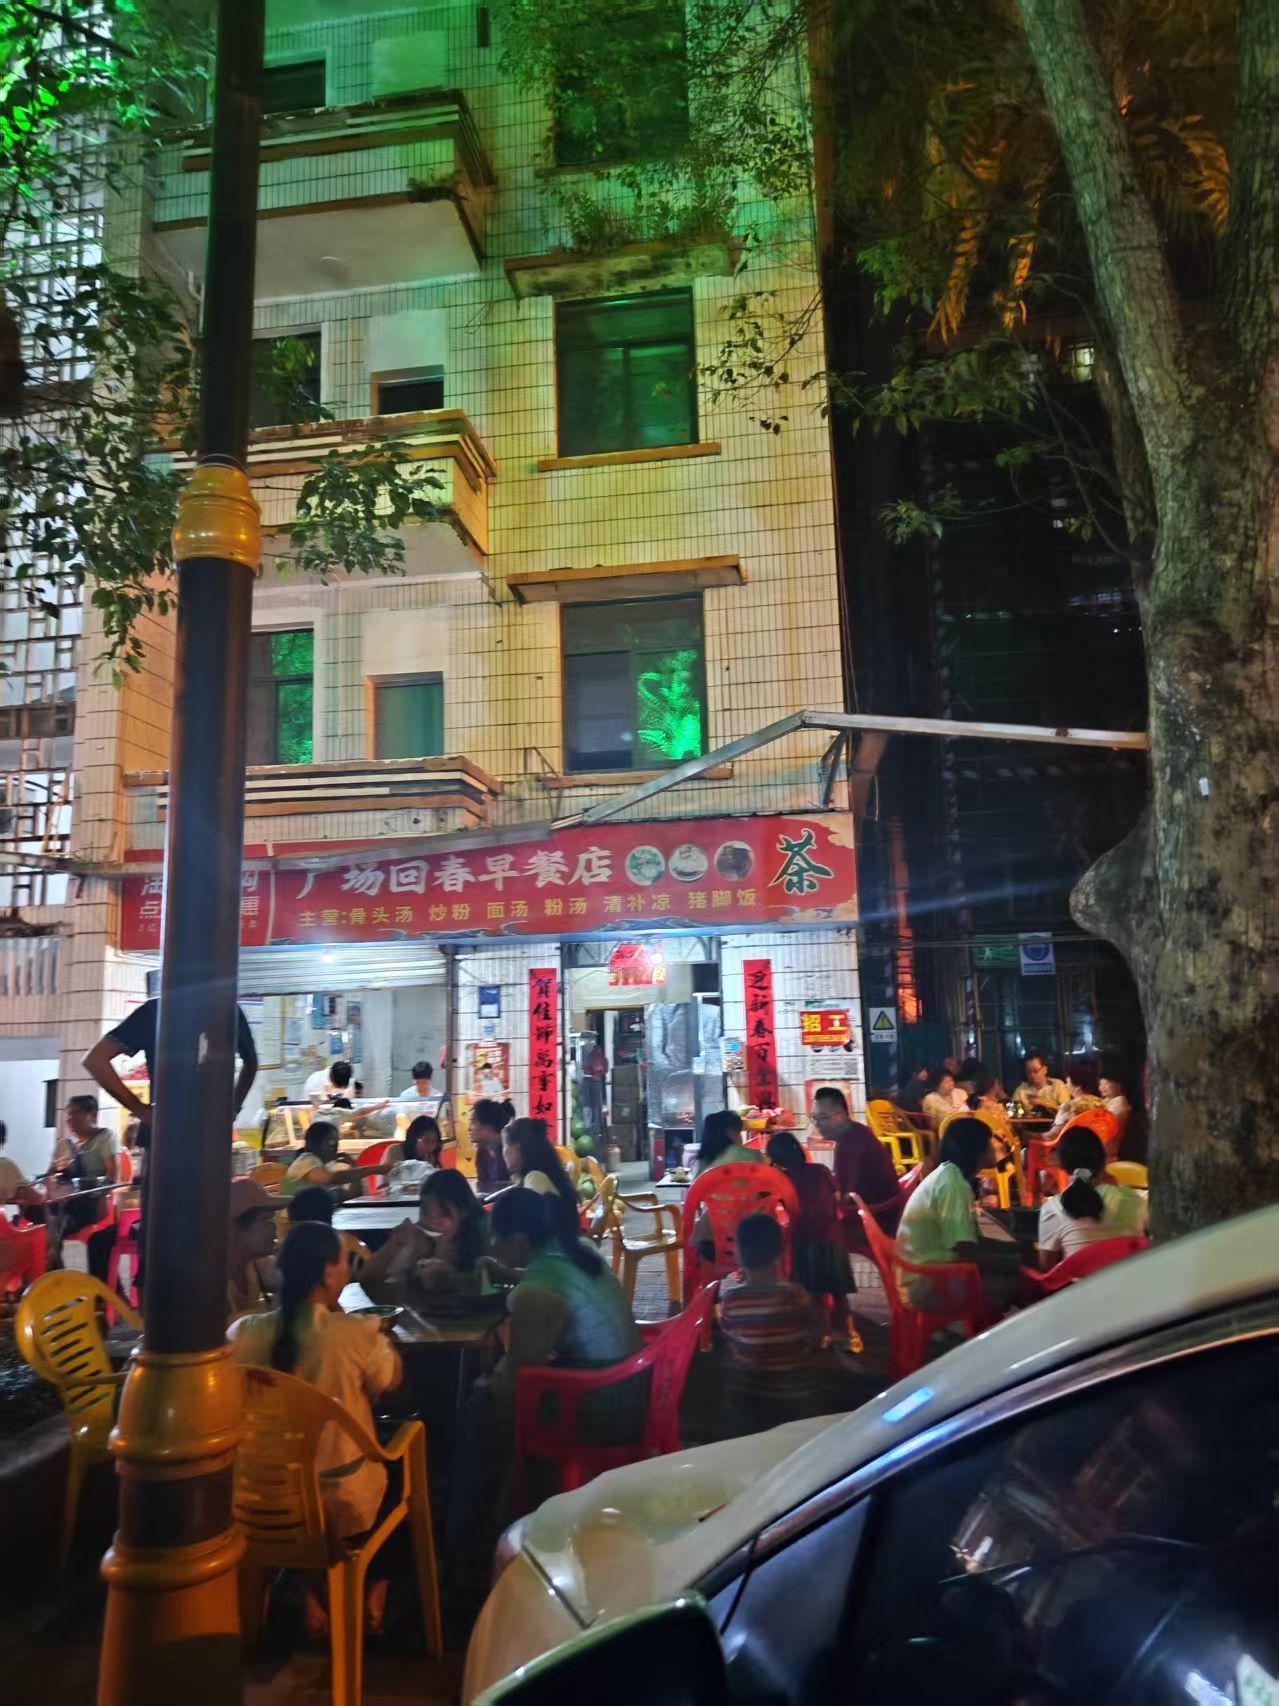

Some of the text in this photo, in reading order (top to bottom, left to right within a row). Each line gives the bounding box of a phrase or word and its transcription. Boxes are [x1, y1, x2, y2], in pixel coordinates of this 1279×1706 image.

[296, 846, 614, 900] 广场回春早餐店
[767, 828, 834, 895] 茶
[428, 903, 471, 921] 炒粉
[486, 900, 529, 919] 面汤
[543, 897, 588, 917] 粉汤
[603, 893, 672, 913] 清补凉
[687, 888, 758, 909] 猪脚饭
[802, 1013, 849, 1032] 招工
